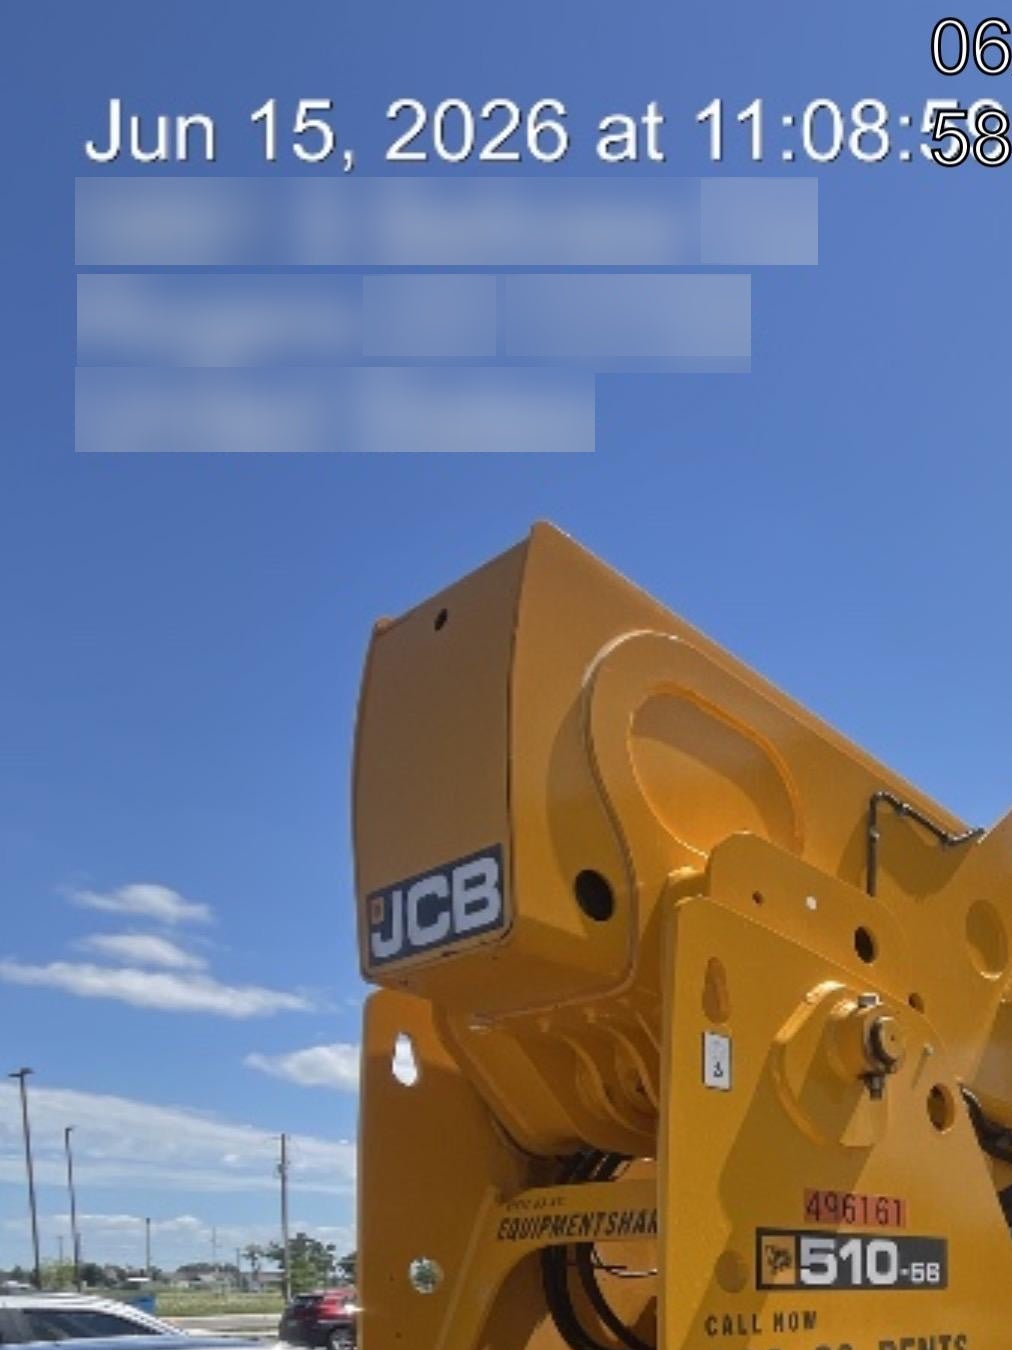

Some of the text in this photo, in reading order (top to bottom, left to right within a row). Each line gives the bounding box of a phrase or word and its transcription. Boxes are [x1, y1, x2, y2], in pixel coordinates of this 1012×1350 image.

[371, 857, 500, 957] JCB
[806, 1190, 902, 1227] 496161
[704, 1310, 818, 1337] CALL NOW
